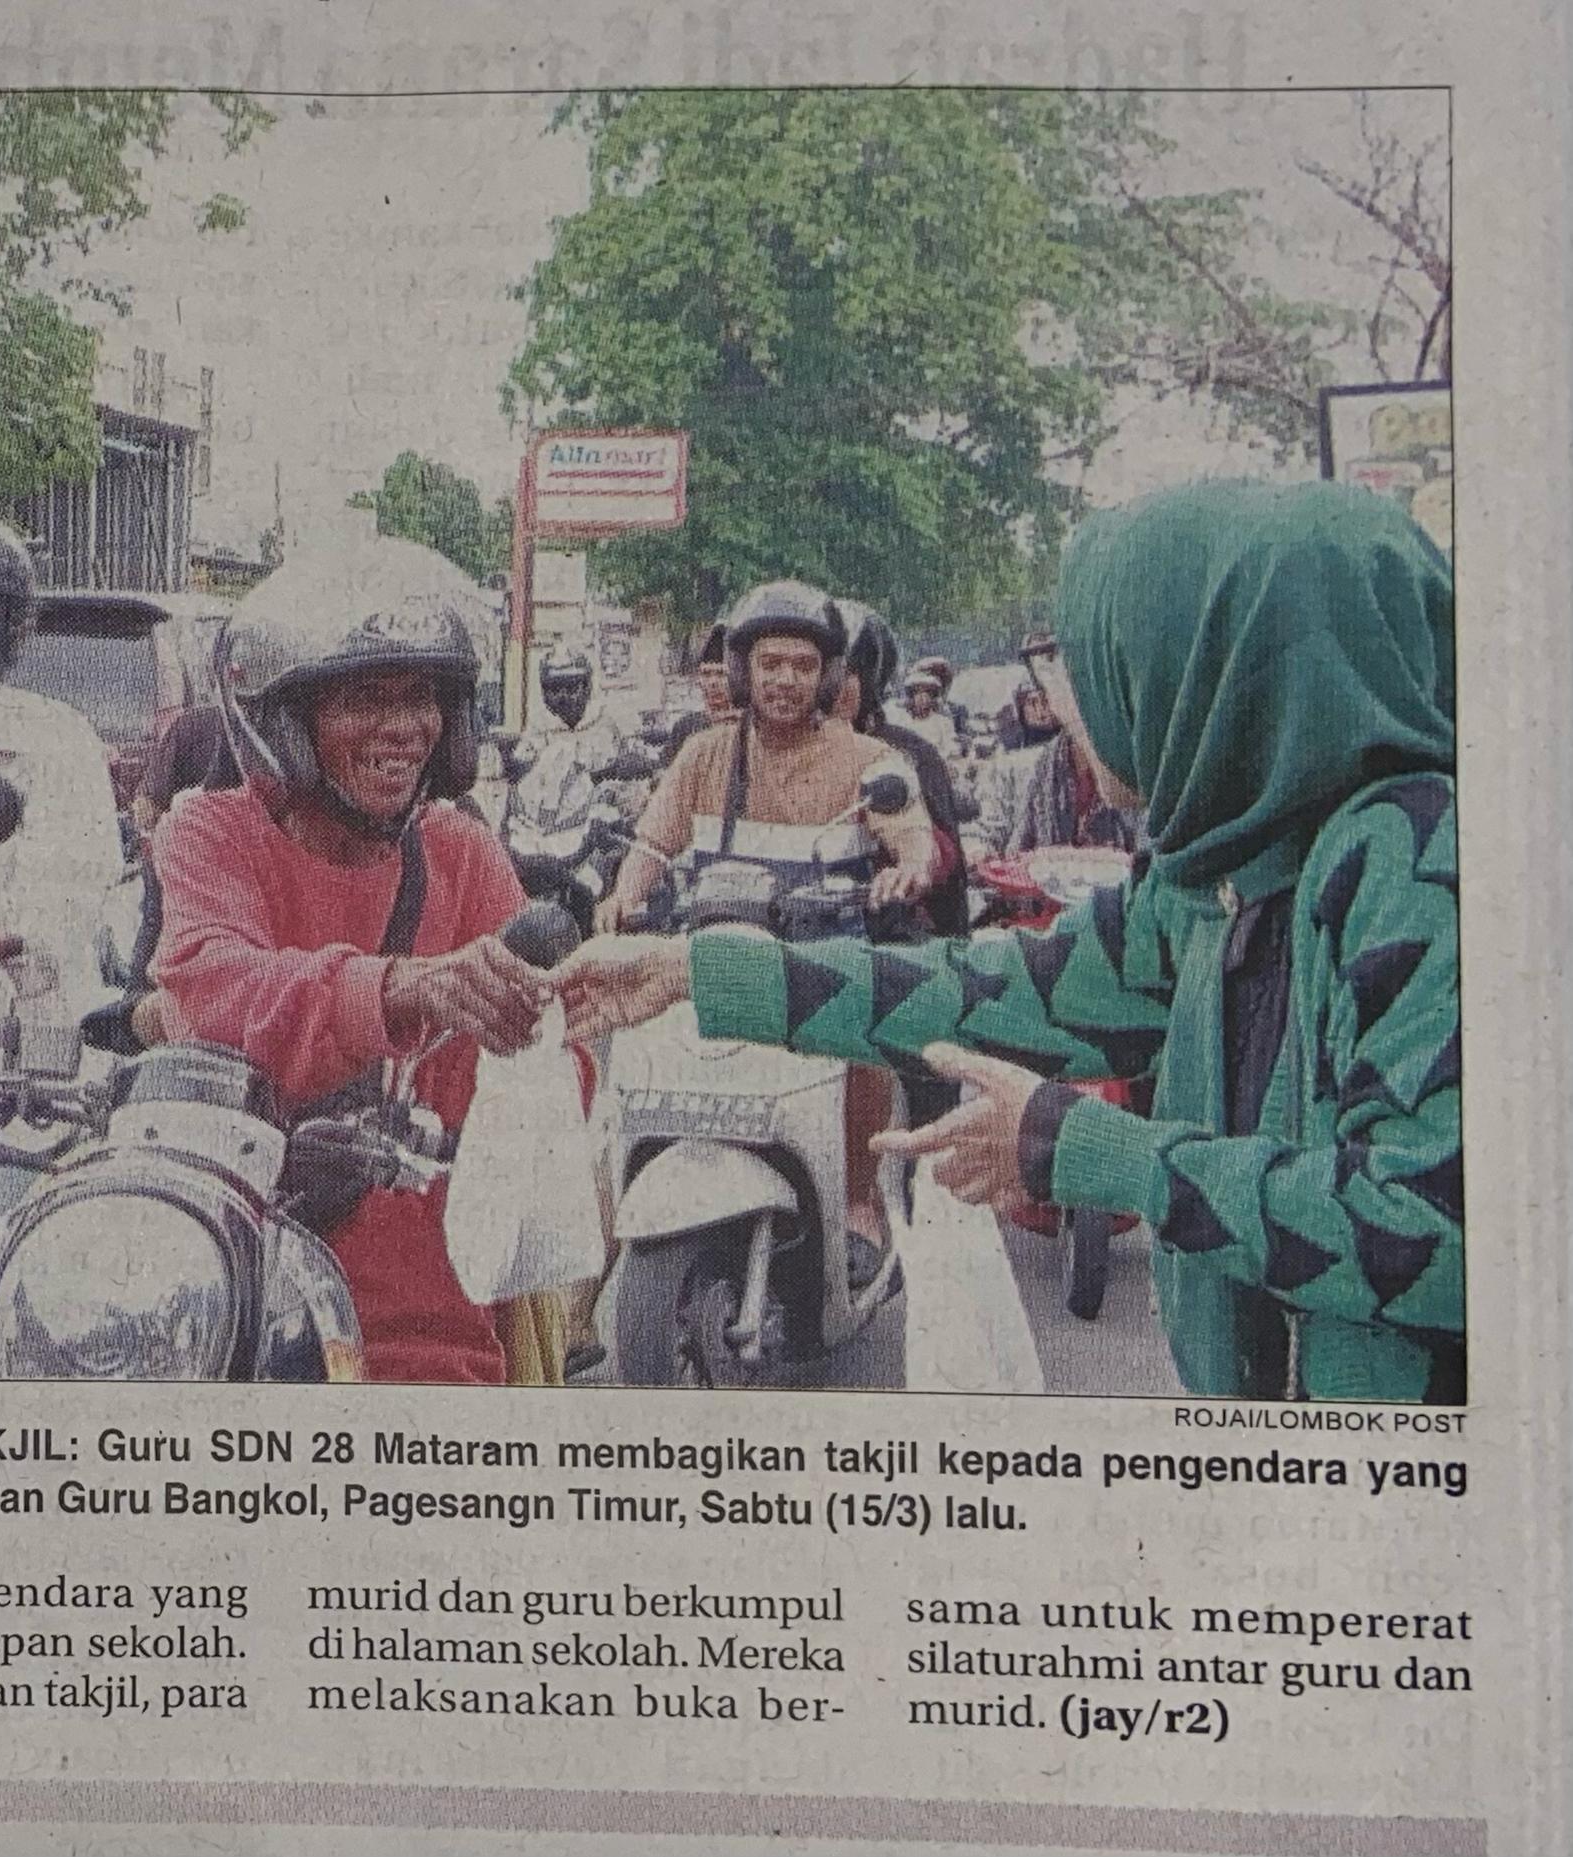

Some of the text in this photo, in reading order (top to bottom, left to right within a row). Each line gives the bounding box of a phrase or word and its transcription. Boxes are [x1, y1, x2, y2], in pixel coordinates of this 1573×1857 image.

[1175, 1407, 1467, 1434] ROJAI/LOMBOK POST
[98, 1428, 190, 1462] Guru
[211, 1429, 291, 1462] SDN
[312, 1432, 354, 1464] 28
[375, 1432, 538, 1466] Mataram
[559, 1437, 805, 1479] membagikan
[824, 1440, 917, 1482] takjil
[939, 1442, 1082, 1485] kepada
[1103, 1450, 1347, 1490] pengendara
[1367, 1461, 1467, 1497] yang
[58, 1480, 150, 1514] Guru
[165, 1482, 328, 1524] Bangkol,
[345, 1484, 554, 1528] Pagesangn
[568, 1488, 686, 1529] Timur,
[701, 1490, 811, 1525] Sabtu
[826, 1493, 931, 1536] (15/3)
[946, 1496, 1026, 1530] lalu.
[151, 1586, 247, 1619] yang
[308, 1577, 843, 1630] murid dan guru berkumpul
[907, 1596, 1472, 1646] sama untuk mempererat
[88, 1625, 245, 1658] sekolah.
[309, 1626, 845, 1672] di halaman sekolah. Mereka
[908, 1640, 1472, 1697] silaturahmi antar guru dan
[44, 1674, 149, 1718] takjil,
[161, 1685, 247, 1718] para
[309, 1677, 844, 1721] melaksanakan buka ber-
[909, 1694, 1229, 1743] murid. (jay/r2)
